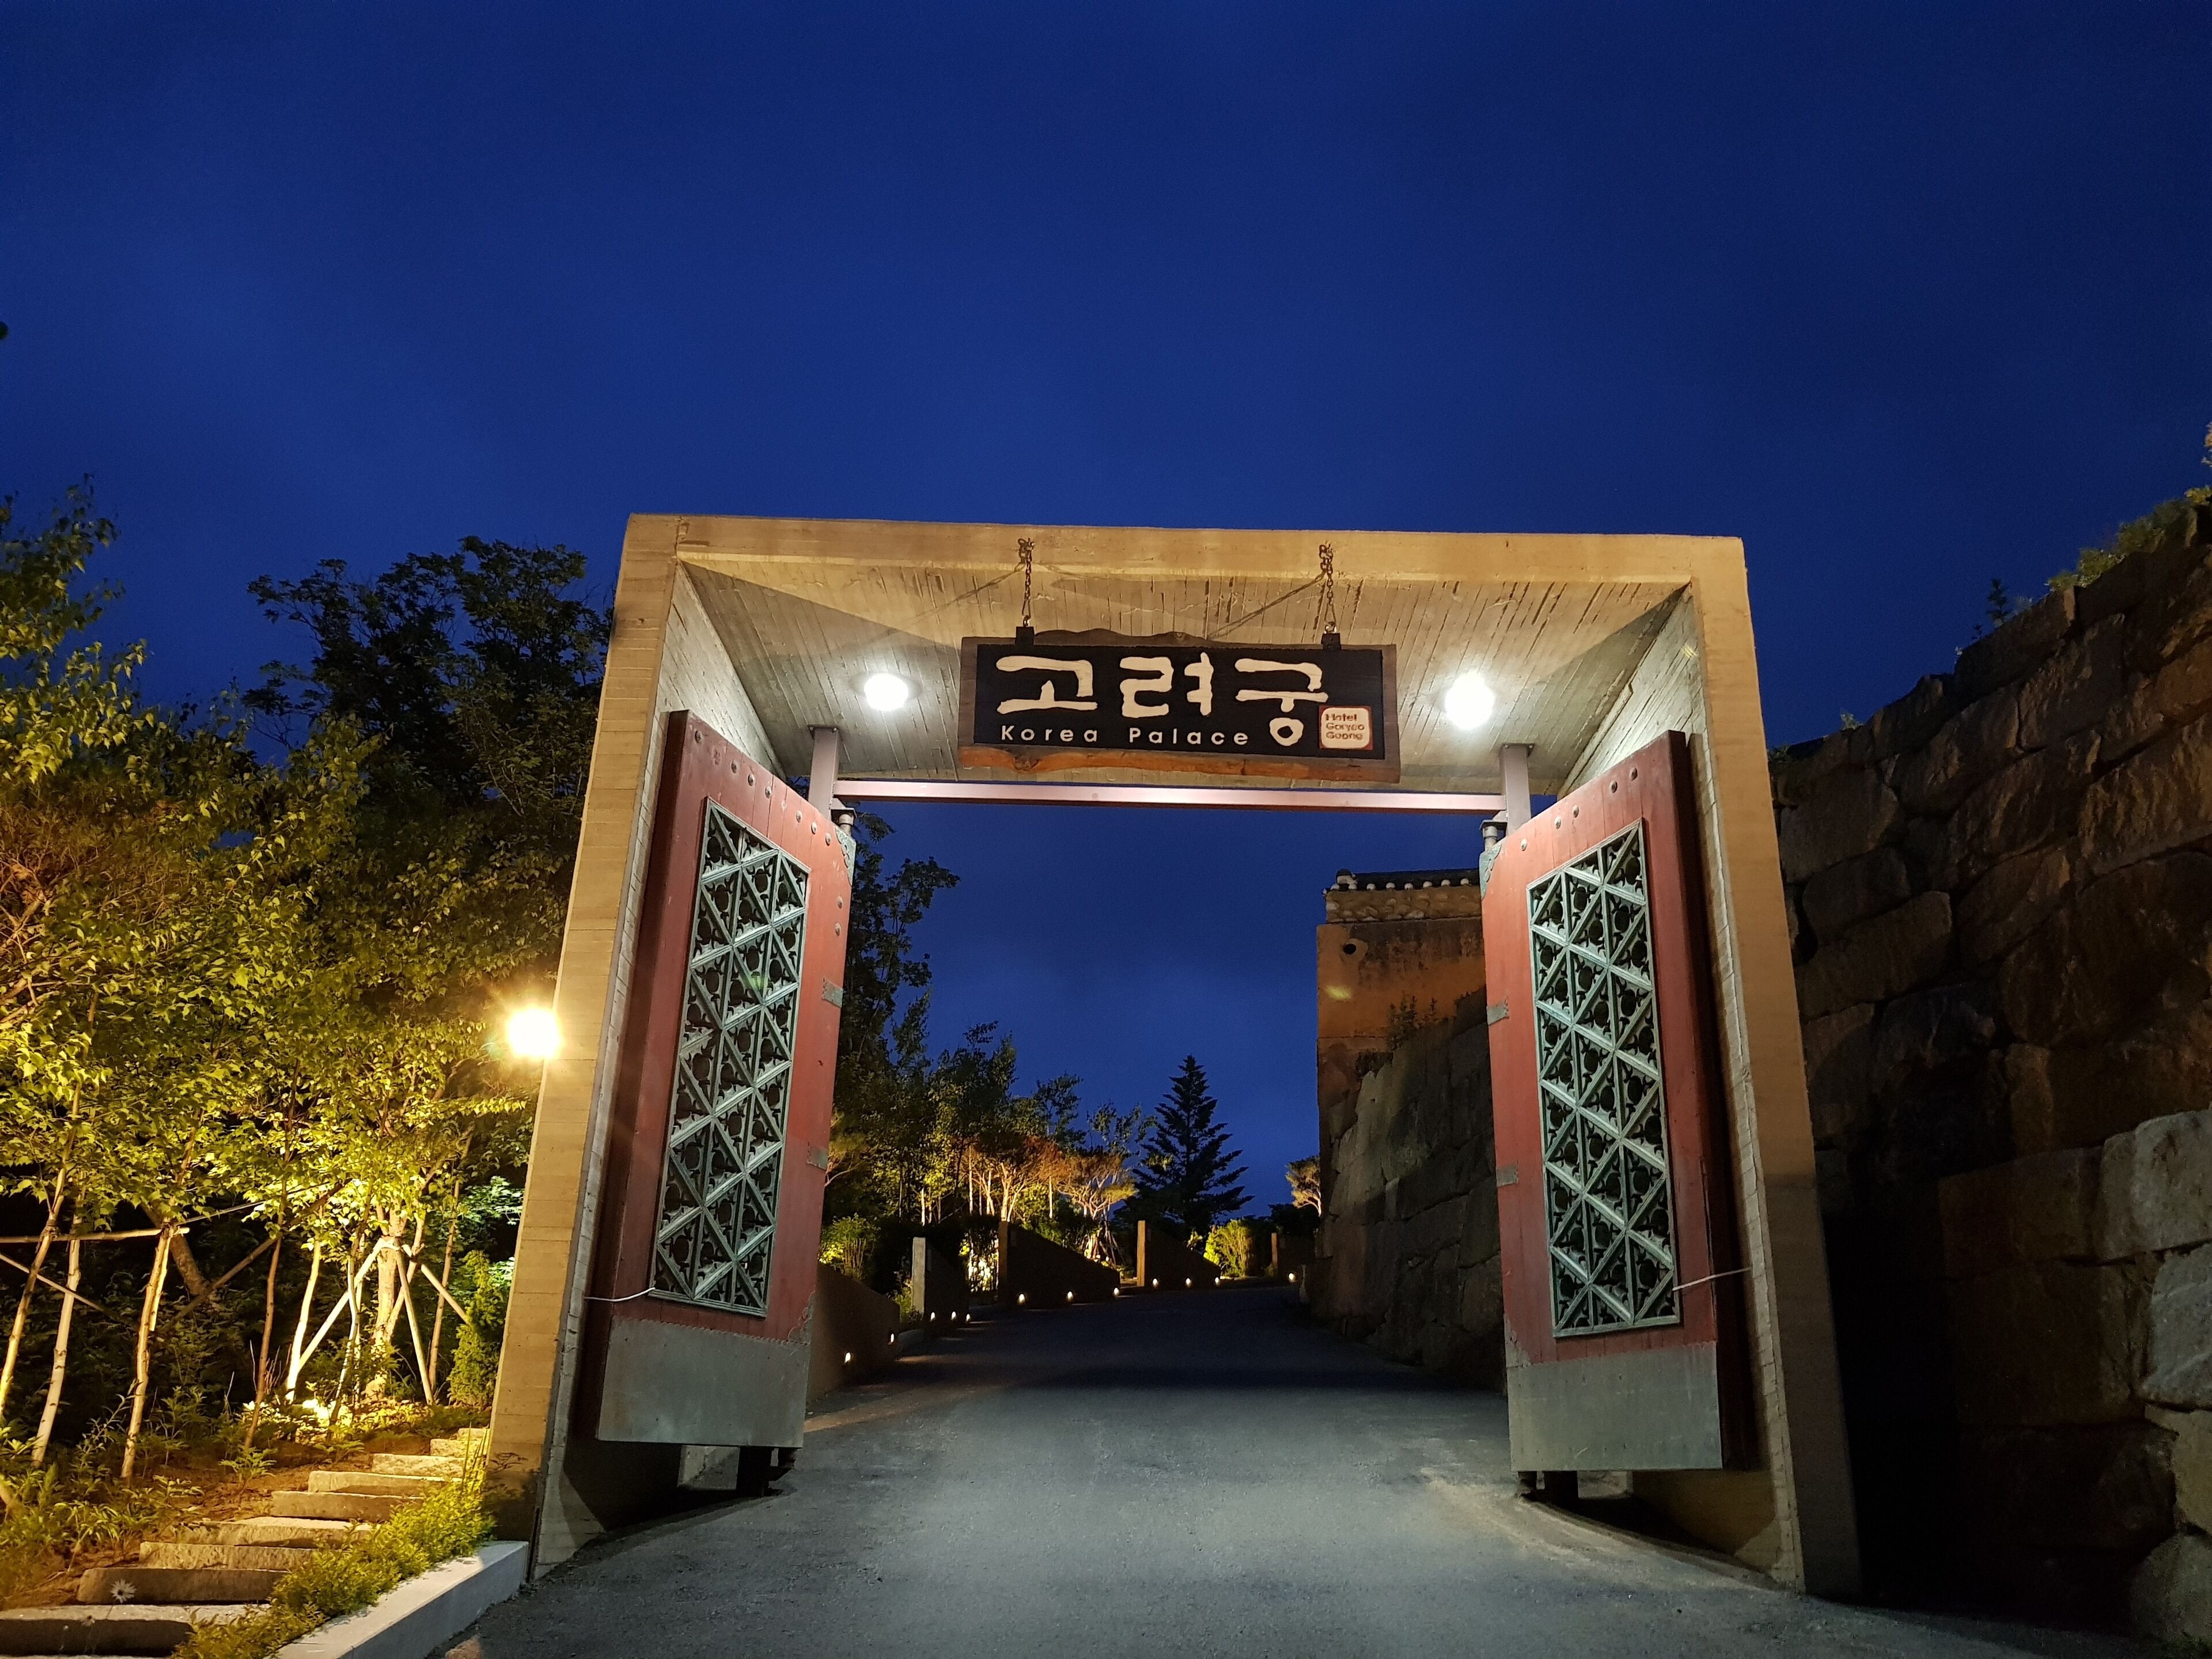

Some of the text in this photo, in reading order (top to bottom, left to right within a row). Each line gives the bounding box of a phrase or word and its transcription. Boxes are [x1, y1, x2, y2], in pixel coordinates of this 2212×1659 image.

[995, 652, 1329, 747] 고려궁
[1001, 725, 1248, 745] Korea Palace
[1325, 731, 1363, 740] Goong
